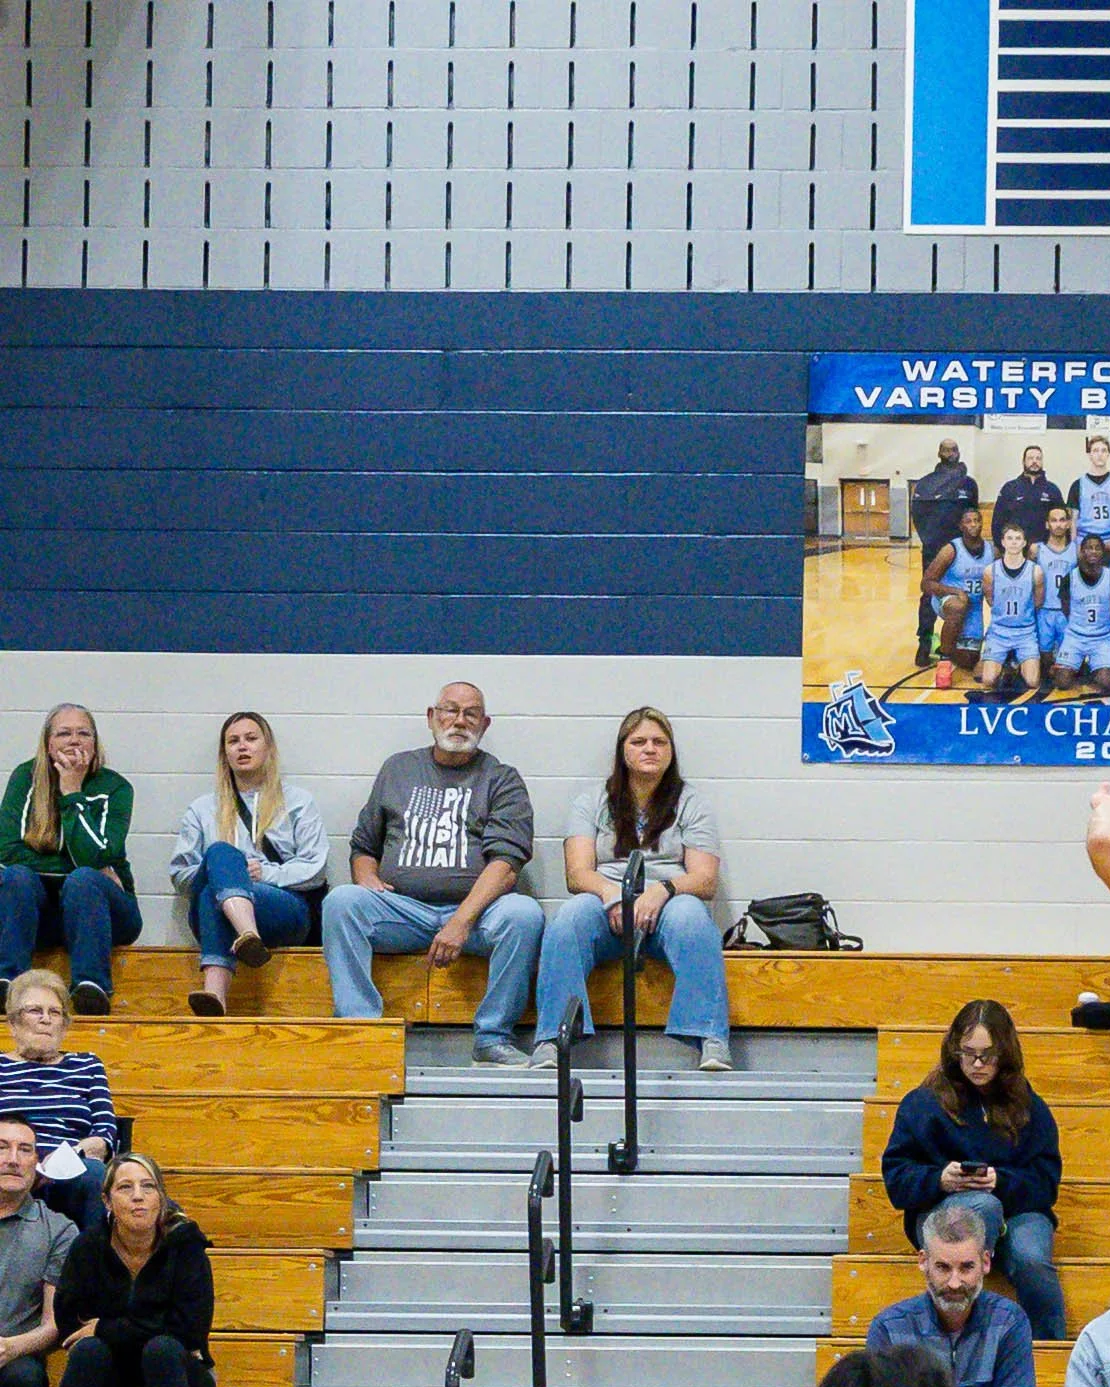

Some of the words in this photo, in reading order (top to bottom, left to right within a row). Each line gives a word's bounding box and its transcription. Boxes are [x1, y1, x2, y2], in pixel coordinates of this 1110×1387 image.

[854, 386, 1056, 409] VARSITY
[1093, 505, 1110, 520] 35
[965, 580, 982, 594] 32
[1006, 601, 1019, 616] 11
[1087, 609, 1097, 623] 3
[958, 706, 1029, 736] LVC
